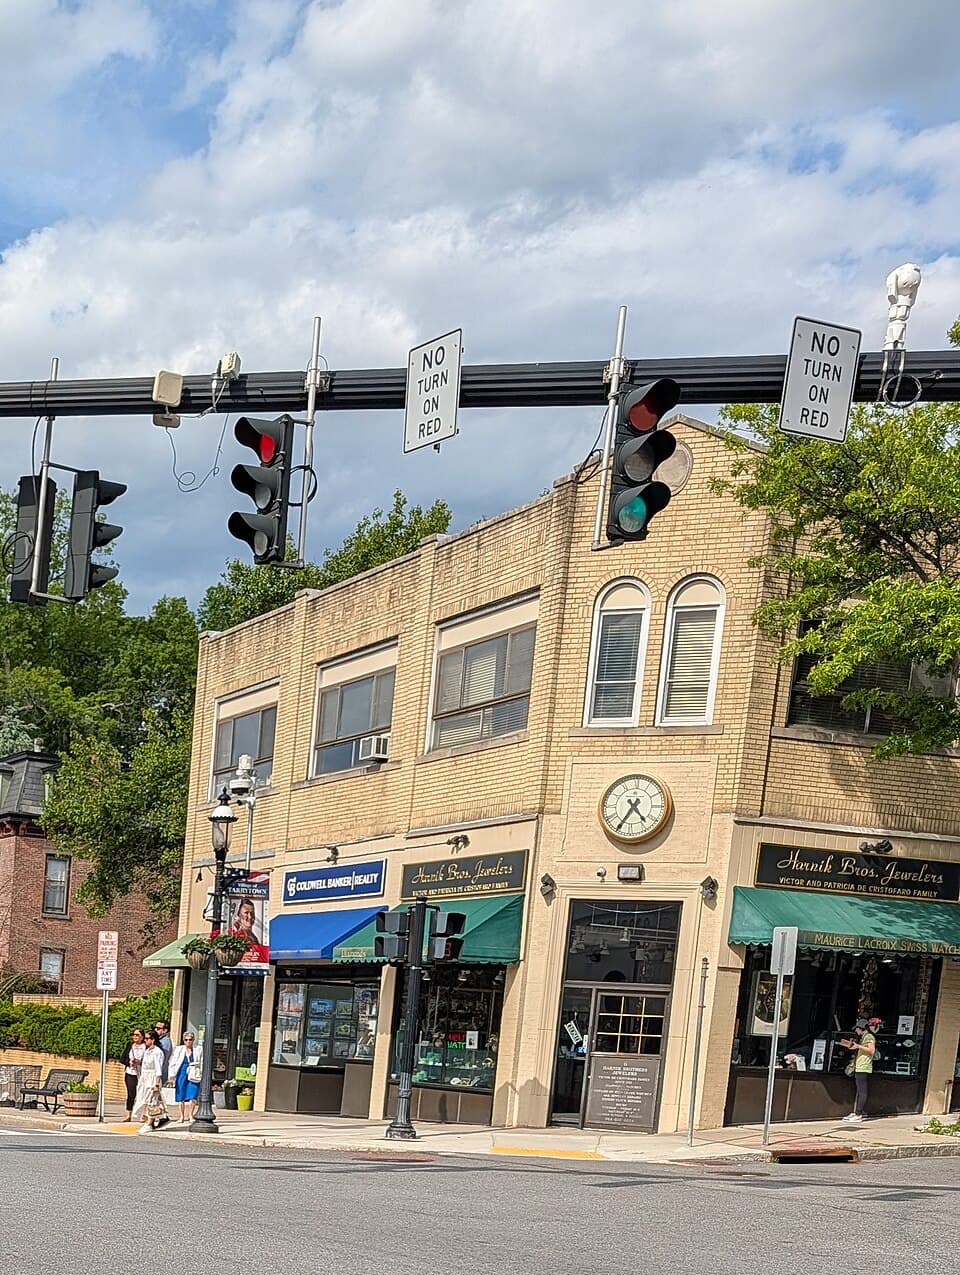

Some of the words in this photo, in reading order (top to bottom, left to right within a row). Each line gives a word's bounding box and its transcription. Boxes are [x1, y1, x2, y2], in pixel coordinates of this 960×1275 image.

[810, 331, 840, 356] NO
[422, 346, 445, 372] NO
[803, 358, 842, 383] TURN
[417, 369, 449, 395] TURN
[423, 395, 440, 415] ON
[808, 385, 829, 404] ON
[418, 417, 441, 439] RED
[800, 408, 829, 428] RED
[471, 857, 513, 884] Jewelers
[776, 849, 835, 874] Harnik
[838, 857, 879, 879] Bros.
[880, 861, 944, 886] Jewelers
[296, 879, 327, 892] COLDWELL
[328, 876, 352, 889] BANKER
[354, 873, 379, 885] REALTY
[779, 877, 804, 886] VICTOR
[806, 880, 822, 888] AND
[823, 881, 855, 891] PATRICIA
[857, 884, 867, 892] DE
[868, 885, 911, 896] CRISTOFARO
[912, 889, 938, 898] FAMILY
[814, 933, 855, 948] MAURICE
[858, 936, 897, 950] LACROIX
[900, 940, 927, 952] SWISS
